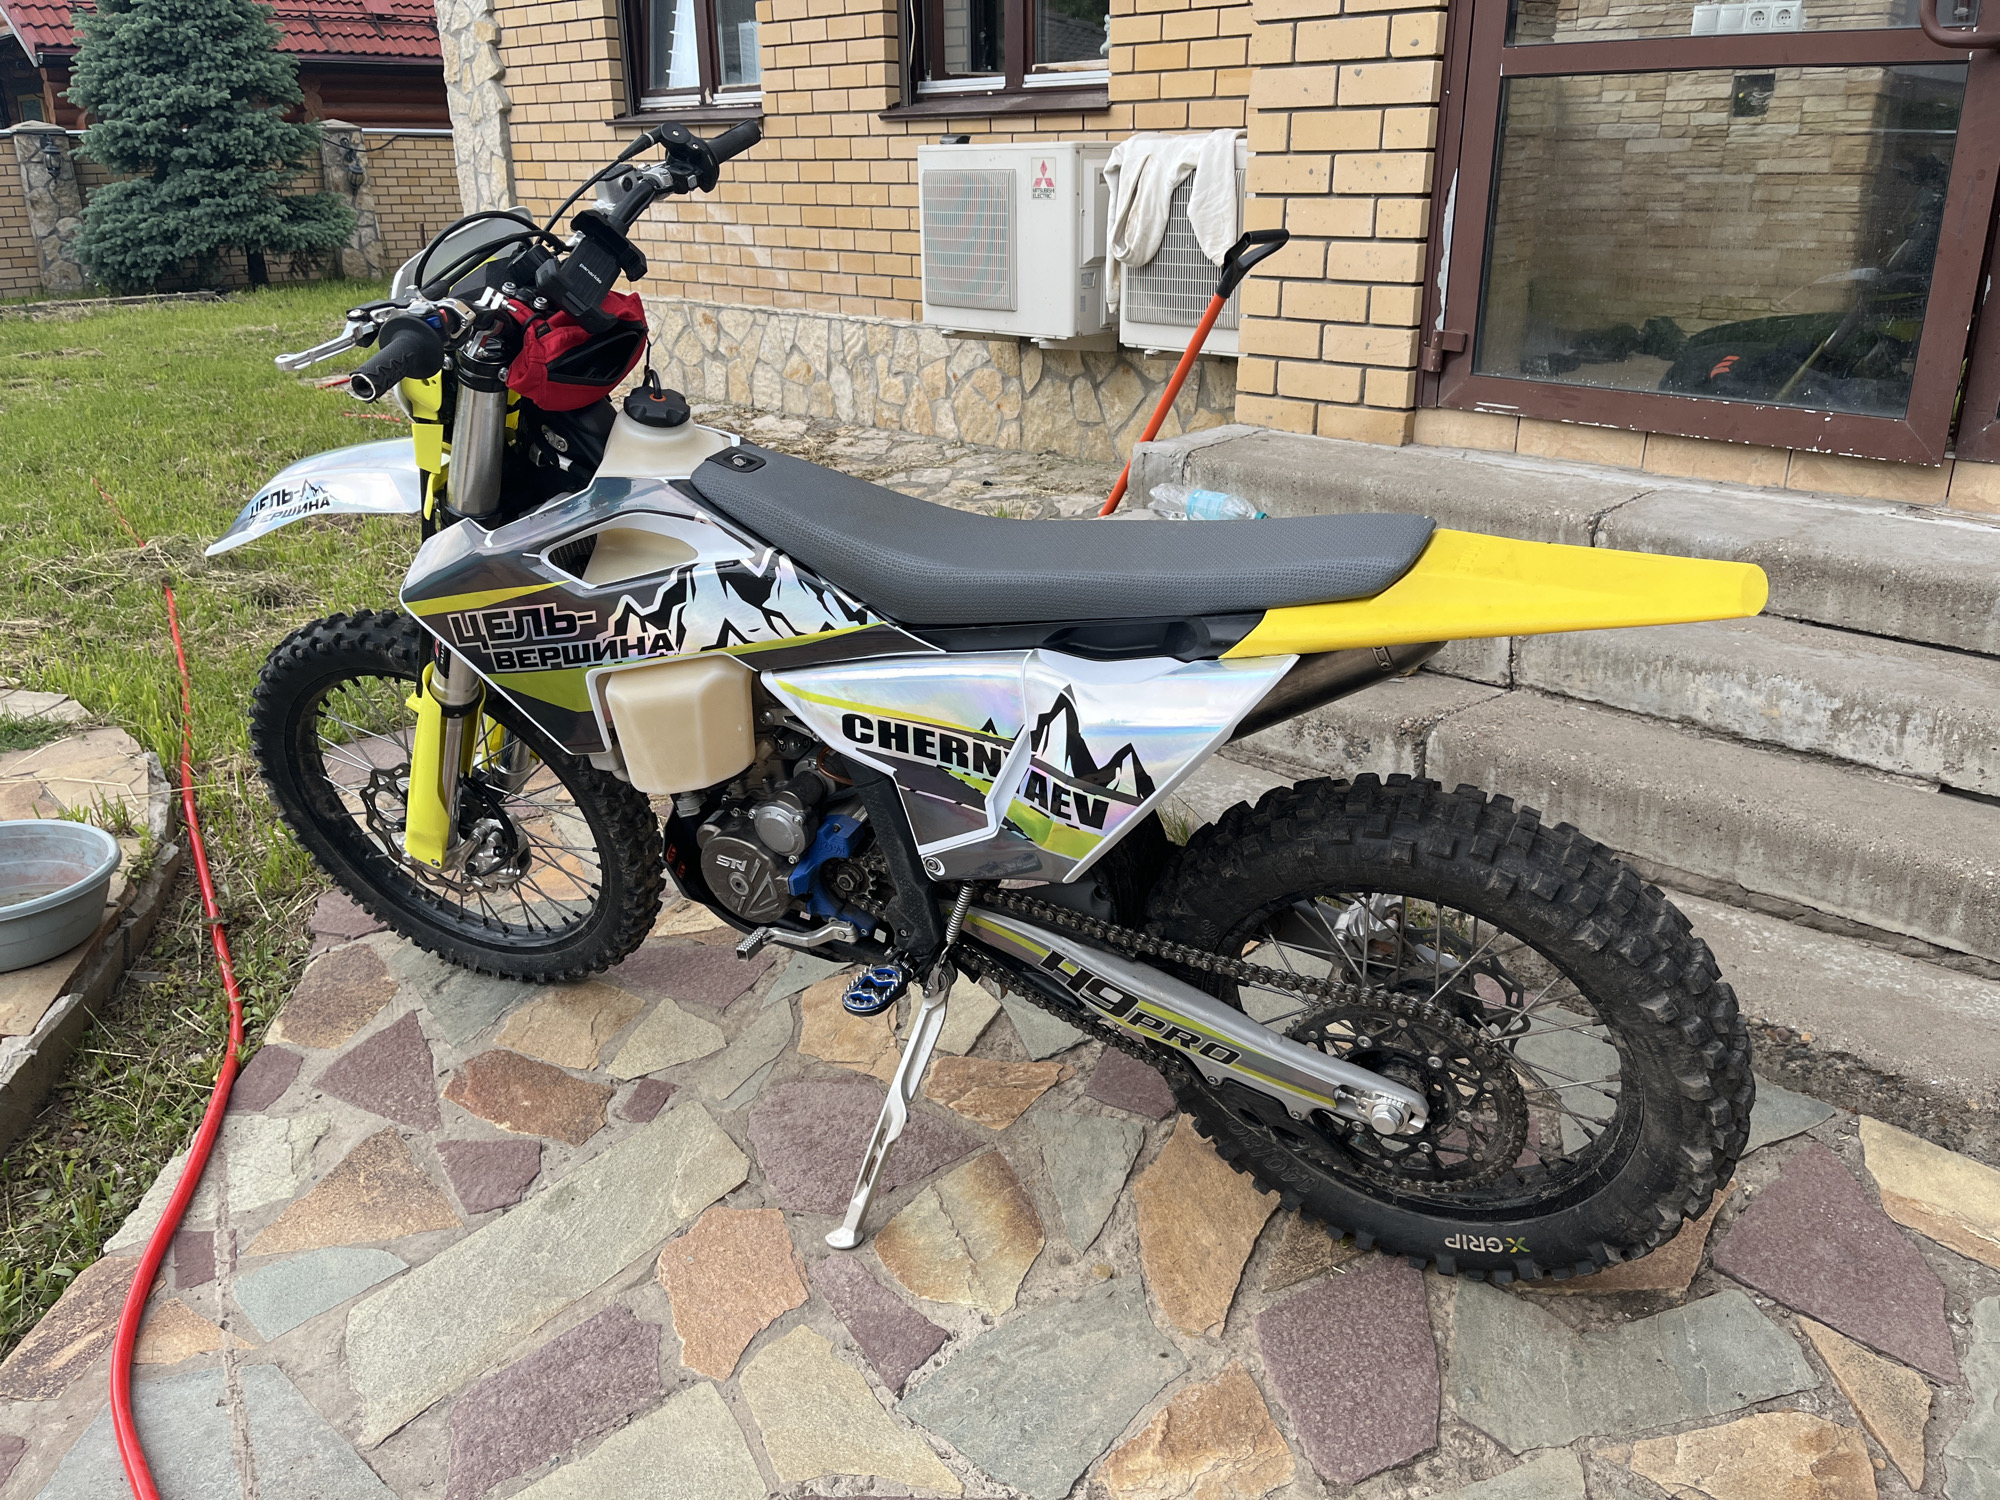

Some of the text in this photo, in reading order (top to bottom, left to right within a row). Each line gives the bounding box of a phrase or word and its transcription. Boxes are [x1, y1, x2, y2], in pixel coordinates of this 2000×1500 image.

[449, 604, 597, 653] ЦЕЛЬ-
[496, 631, 677, 670] ВЕРШИНА
[1444, 1233, 1531, 1254] X-GRIP
